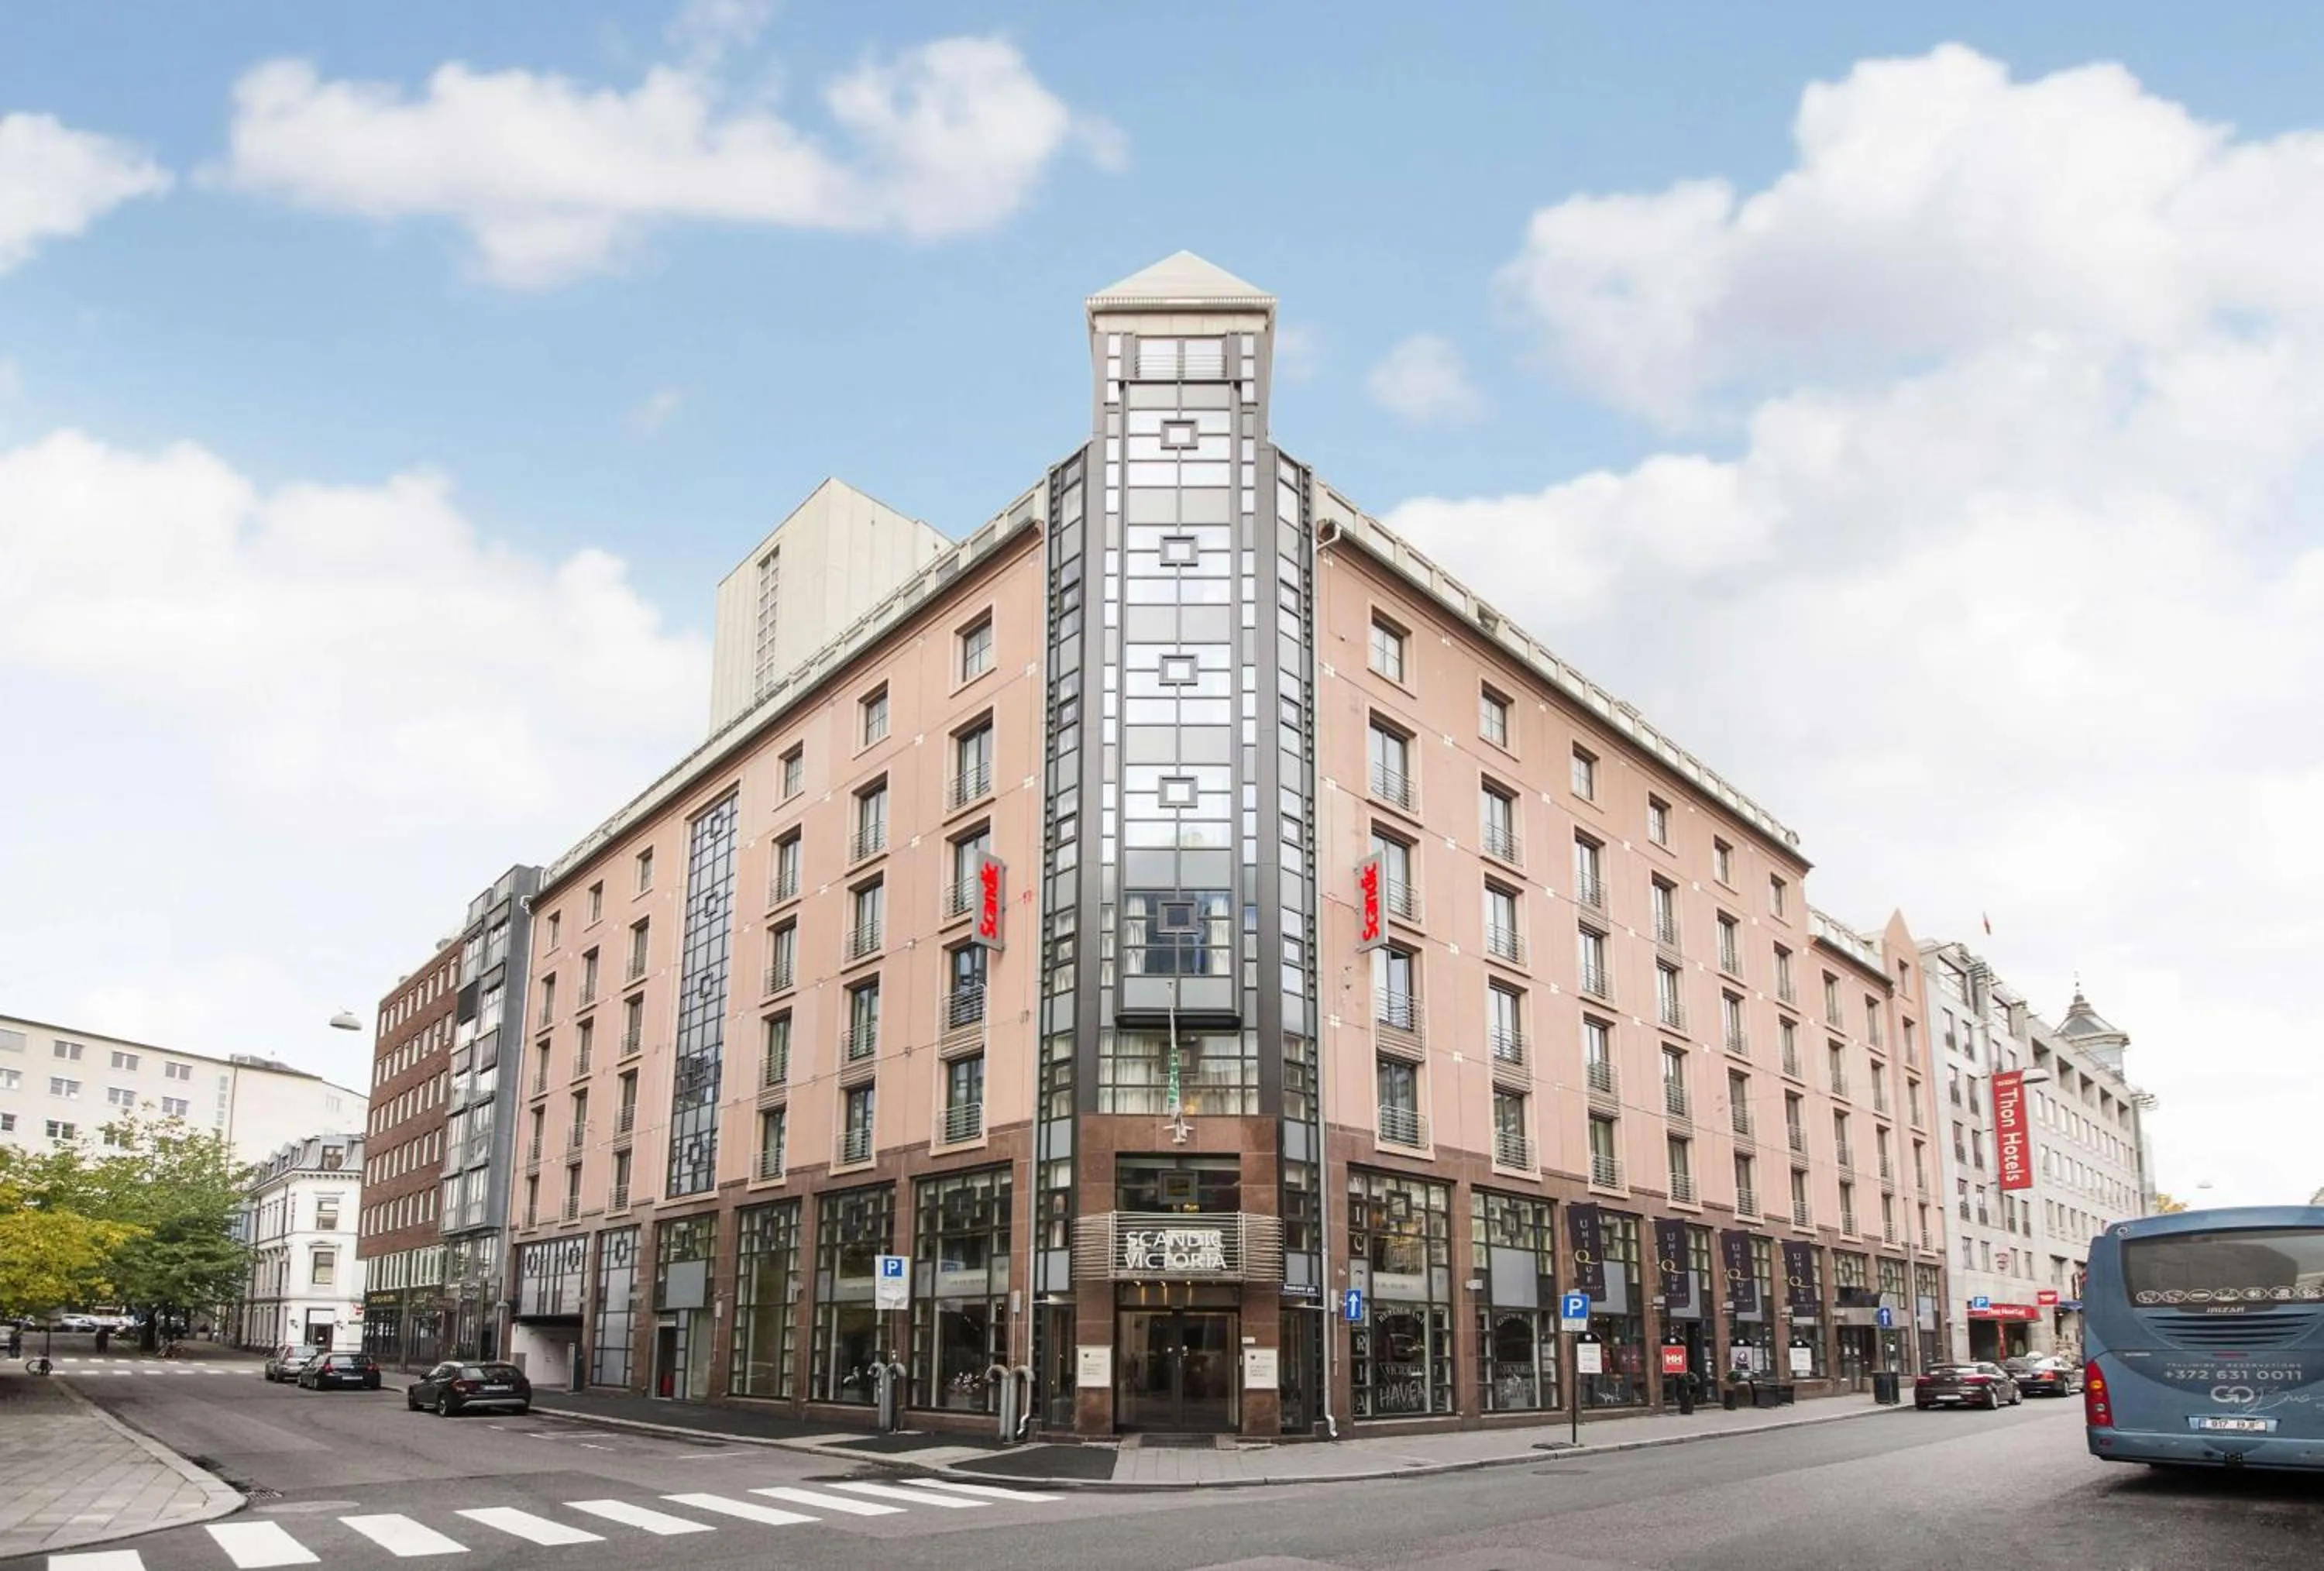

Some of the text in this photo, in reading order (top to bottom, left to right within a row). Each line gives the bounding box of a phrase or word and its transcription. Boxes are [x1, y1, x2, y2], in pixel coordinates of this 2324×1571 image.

[979, 861, 999, 940] Scandic
[1360, 862, 1378, 940] Scandic
[1999, 1087, 2019, 1127] Thon
[2002, 1132, 2025, 1182] Hotels
[1126, 1230, 1224, 1248] SCANDIC
[1575, 1219, 1600, 1284] UNIQUE
[887, 1260, 898, 1275] P
[1125, 1252, 1228, 1270] VICTORIA
[1661, 1232, 1686, 1291] UNIQUE
[1569, 1298, 1583, 1316] P
[1976, 1297, 1985, 1308] P
[2165, 1370, 2302, 1380] +372 631 0011
